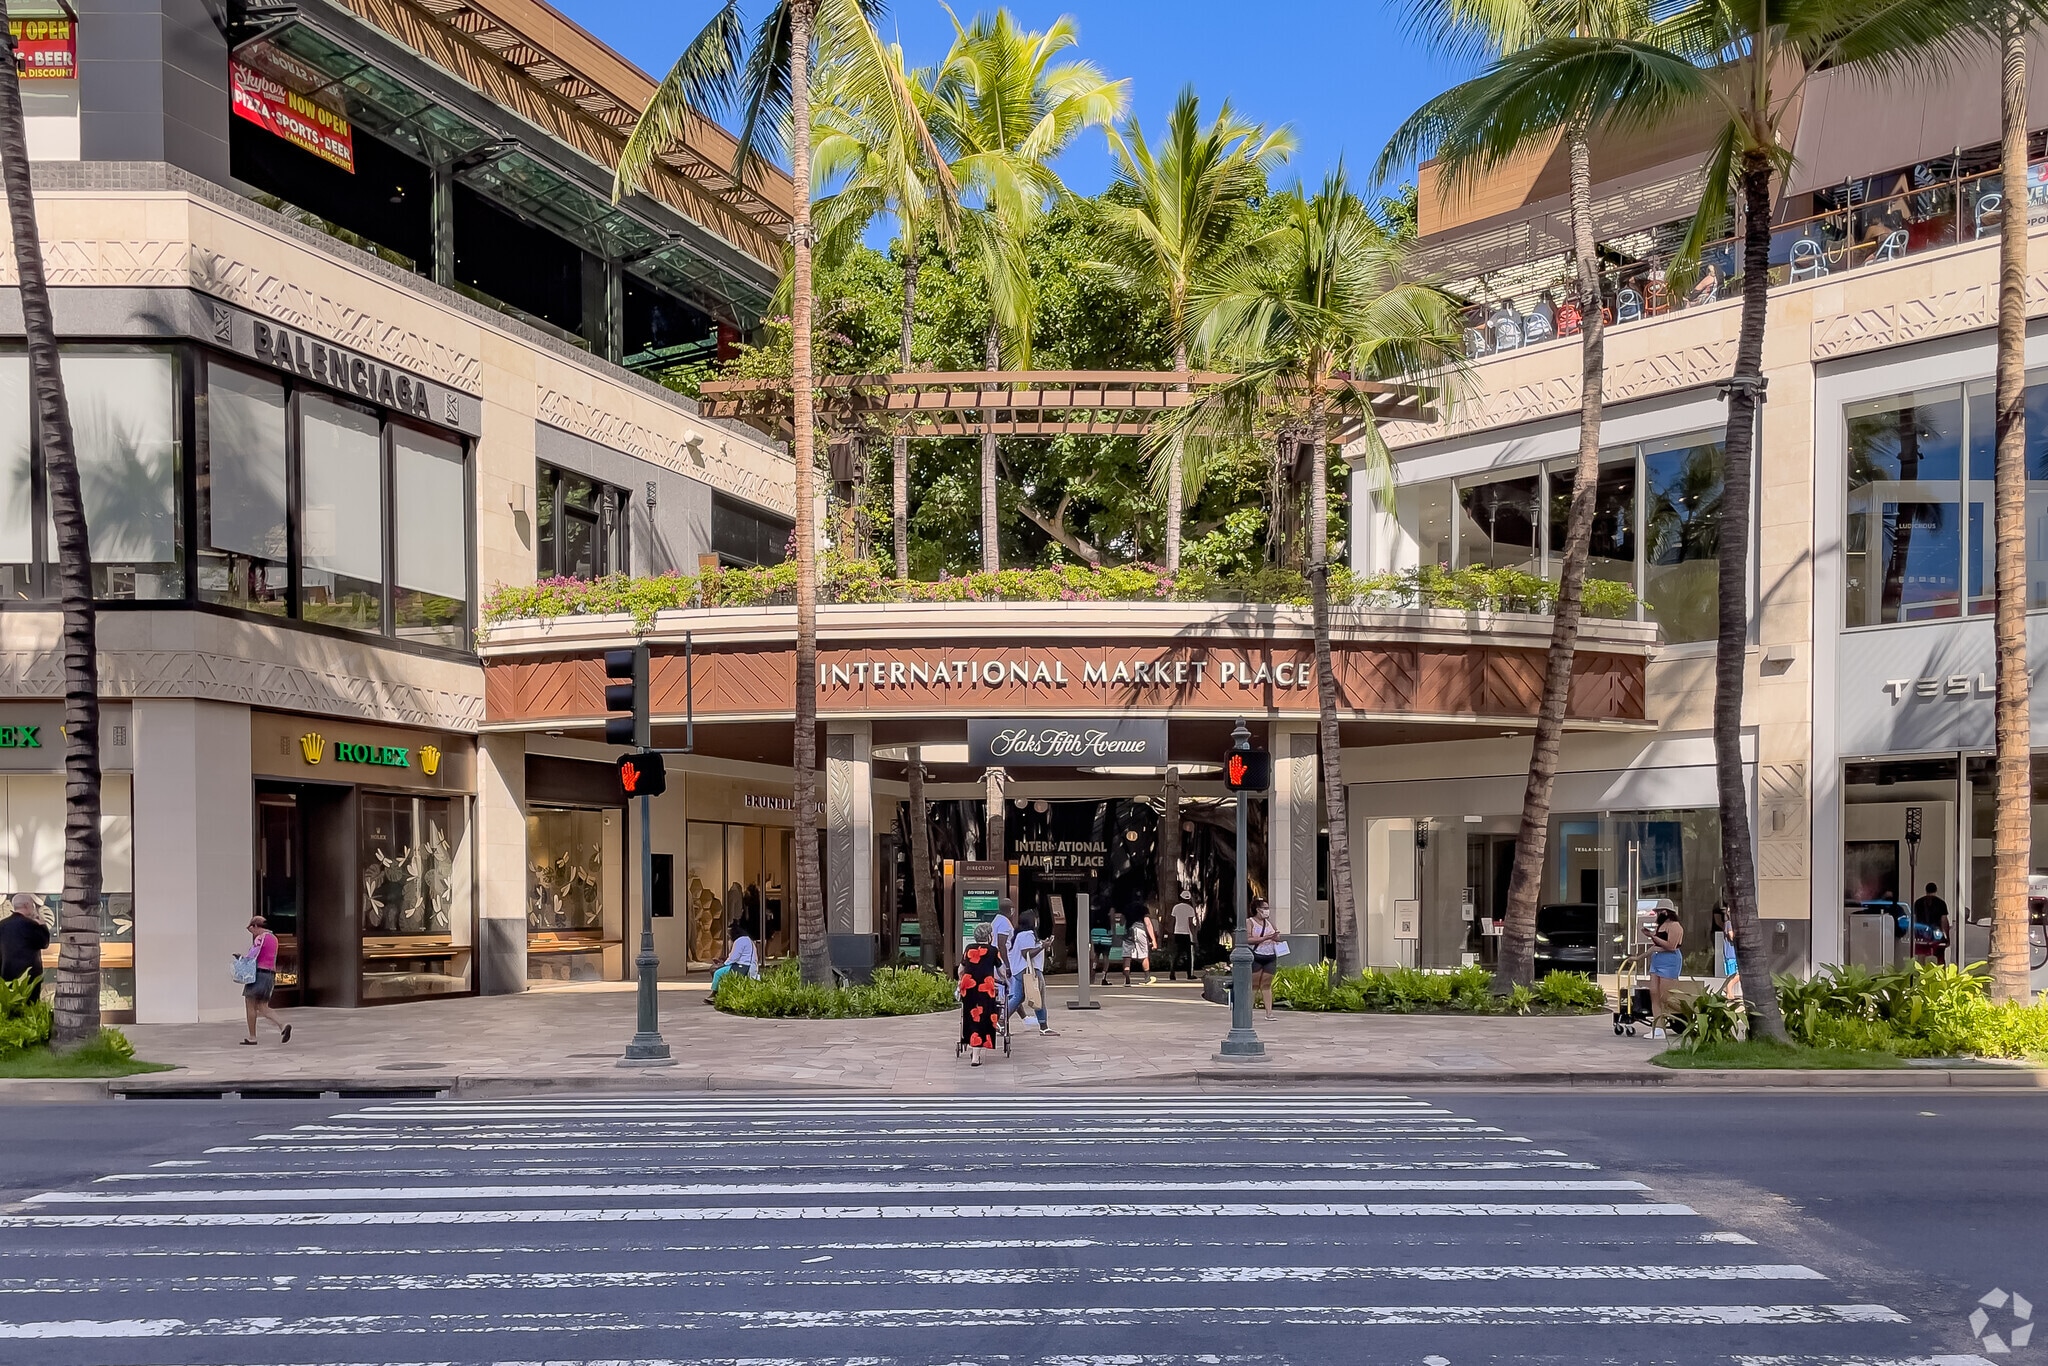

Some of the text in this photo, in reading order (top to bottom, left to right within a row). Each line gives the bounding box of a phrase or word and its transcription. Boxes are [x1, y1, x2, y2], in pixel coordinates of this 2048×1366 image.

[26, 21, 70, 40] OPEN
[35, 51, 73, 66] BEER
[28, 68, 73, 77] DISCOUNT
[233, 62, 287, 97] Skybox
[234, 89, 271, 119] PIZZA
[275, 111, 319, 144] SPORTS
[324, 136, 351, 160] BEER
[288, 91, 316, 119] NOW
[318, 107, 348, 137] OPEN
[253, 320, 430, 420] BALENCIAGA
[820, 660, 1310, 686] INTERNATIONAL MARKET PLACE
[1886, 669, 2033, 698] TESL
[337, 741, 410, 767] ROLEX
[990, 729, 1146, 757] Saks Fifth Avenue
[744, 794, 795, 811] BRUNELL
[1019, 854, 1104, 867] MARET PLACE
